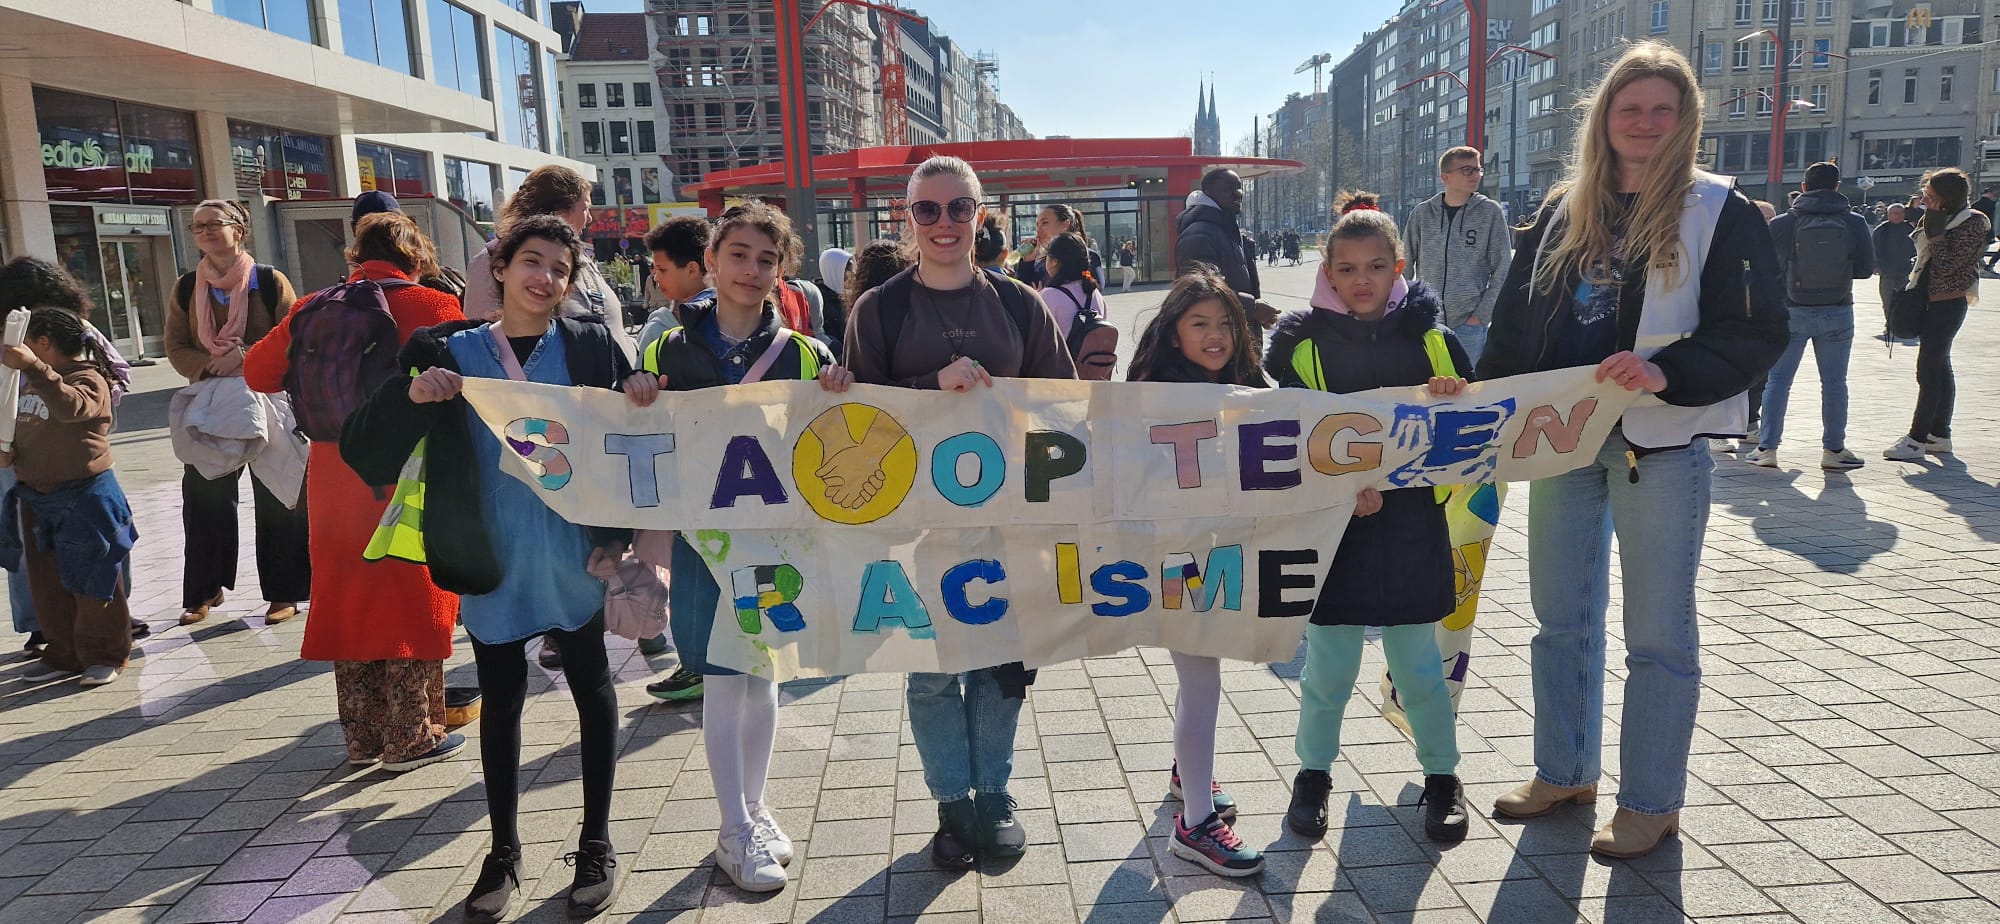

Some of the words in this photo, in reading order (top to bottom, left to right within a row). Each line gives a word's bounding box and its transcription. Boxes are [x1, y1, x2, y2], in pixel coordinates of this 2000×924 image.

[40, 140, 83, 168] edia
[125, 144, 153, 174] arkt
[1465, 229, 1477, 246] S
[942, 329, 977, 338] coffee
[1149, 397, 1598, 491] TEGEN
[731, 543, 1319, 640] RACISME
